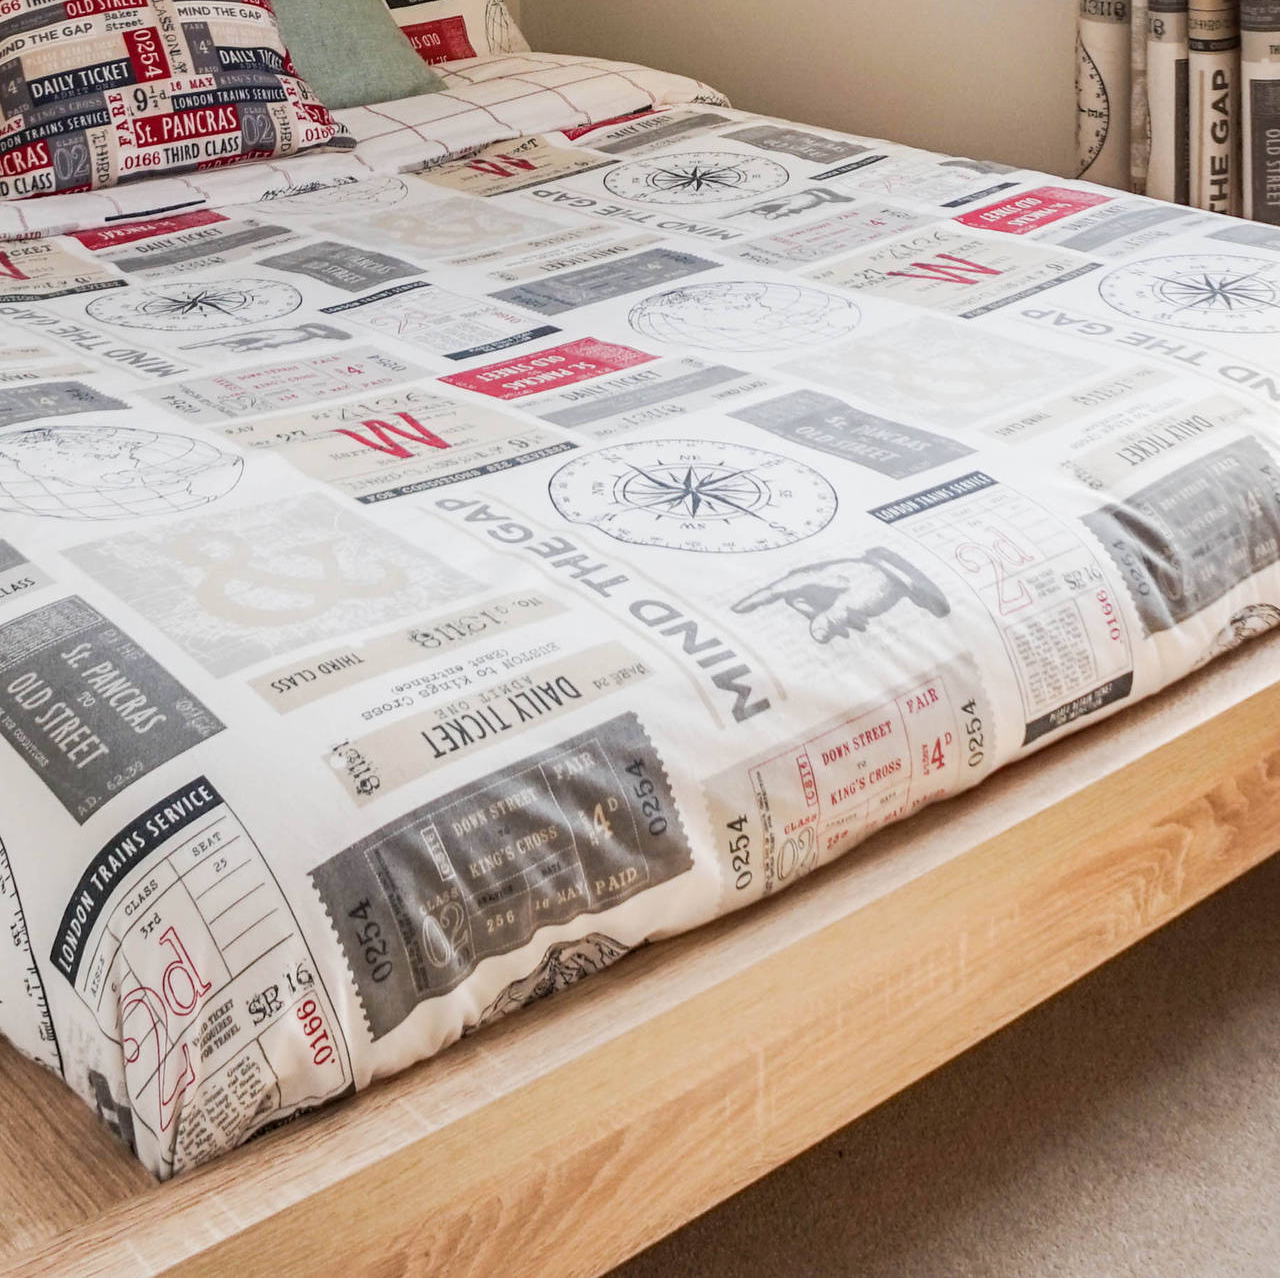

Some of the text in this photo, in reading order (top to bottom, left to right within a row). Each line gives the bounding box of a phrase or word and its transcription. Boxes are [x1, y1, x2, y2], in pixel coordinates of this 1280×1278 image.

[66, 2, 95, 17] OLD
[105, 10, 139, 21] Baker
[105, 18, 145, 32] Street
[177, 7, 262, 20] MIND THE GAP
[29, 30, 59, 45] THE
[63, 23, 93, 38] GAP
[133, 29, 164, 78] 0254
[220, 50, 257, 65] DAILY
[31, 62, 131, 99] DAILY TICKET
[170, 77, 213, 92] 16 MAY
[174, 88, 286, 110] LONDON TRAINS SERVICE
[26, 111, 109, 141] TRAINS SERVICE
[109, 92, 134, 147] FARE
[136, 107, 237, 143] St. PANCRAS
[163, 142, 200, 161] THIRD
[206, 136, 240, 155] CLASS
[14, 173, 53, 194] CLASS
[1021, 308, 1114, 336] GAP
[46, 320, 190, 379] MIND THE
[1115, 332, 1208, 367] THE
[609, 370, 663, 391] TICKET
[434, 497, 772, 723] MIND THE GAP
[61, 641, 168, 734] St. PANCRAS
[270, 650, 366, 695] THIRD CLASS
[361, 672, 473, 721] Kings Cross
[906, 688, 939, 714] FAIR
[7, 672, 110, 769] OLD STREET
[421, 675, 583, 759] DAILY TICKET
[960, 698, 984, 768] 0254
[821, 721, 893, 766] DOWN STREET
[625, 758, 668, 837] 0254
[830, 775, 866, 805] KING'S
[869, 758, 902, 784] CROSS
[452, 786, 538, 837] DOWN STREET
[191, 832, 223, 858] SEAT
[469, 825, 558, 878] KING'S CROSS
[726, 814, 753, 891] 0254
[58, 783, 214, 971] LONDON TRAINS SERVICE
[595, 867, 638, 895] PAID
[124, 879, 160, 917] CLASS
[140, 912, 162, 941] 3rd
[348, 897, 393, 983] 0254
[207, 999, 235, 1024] TICKET
